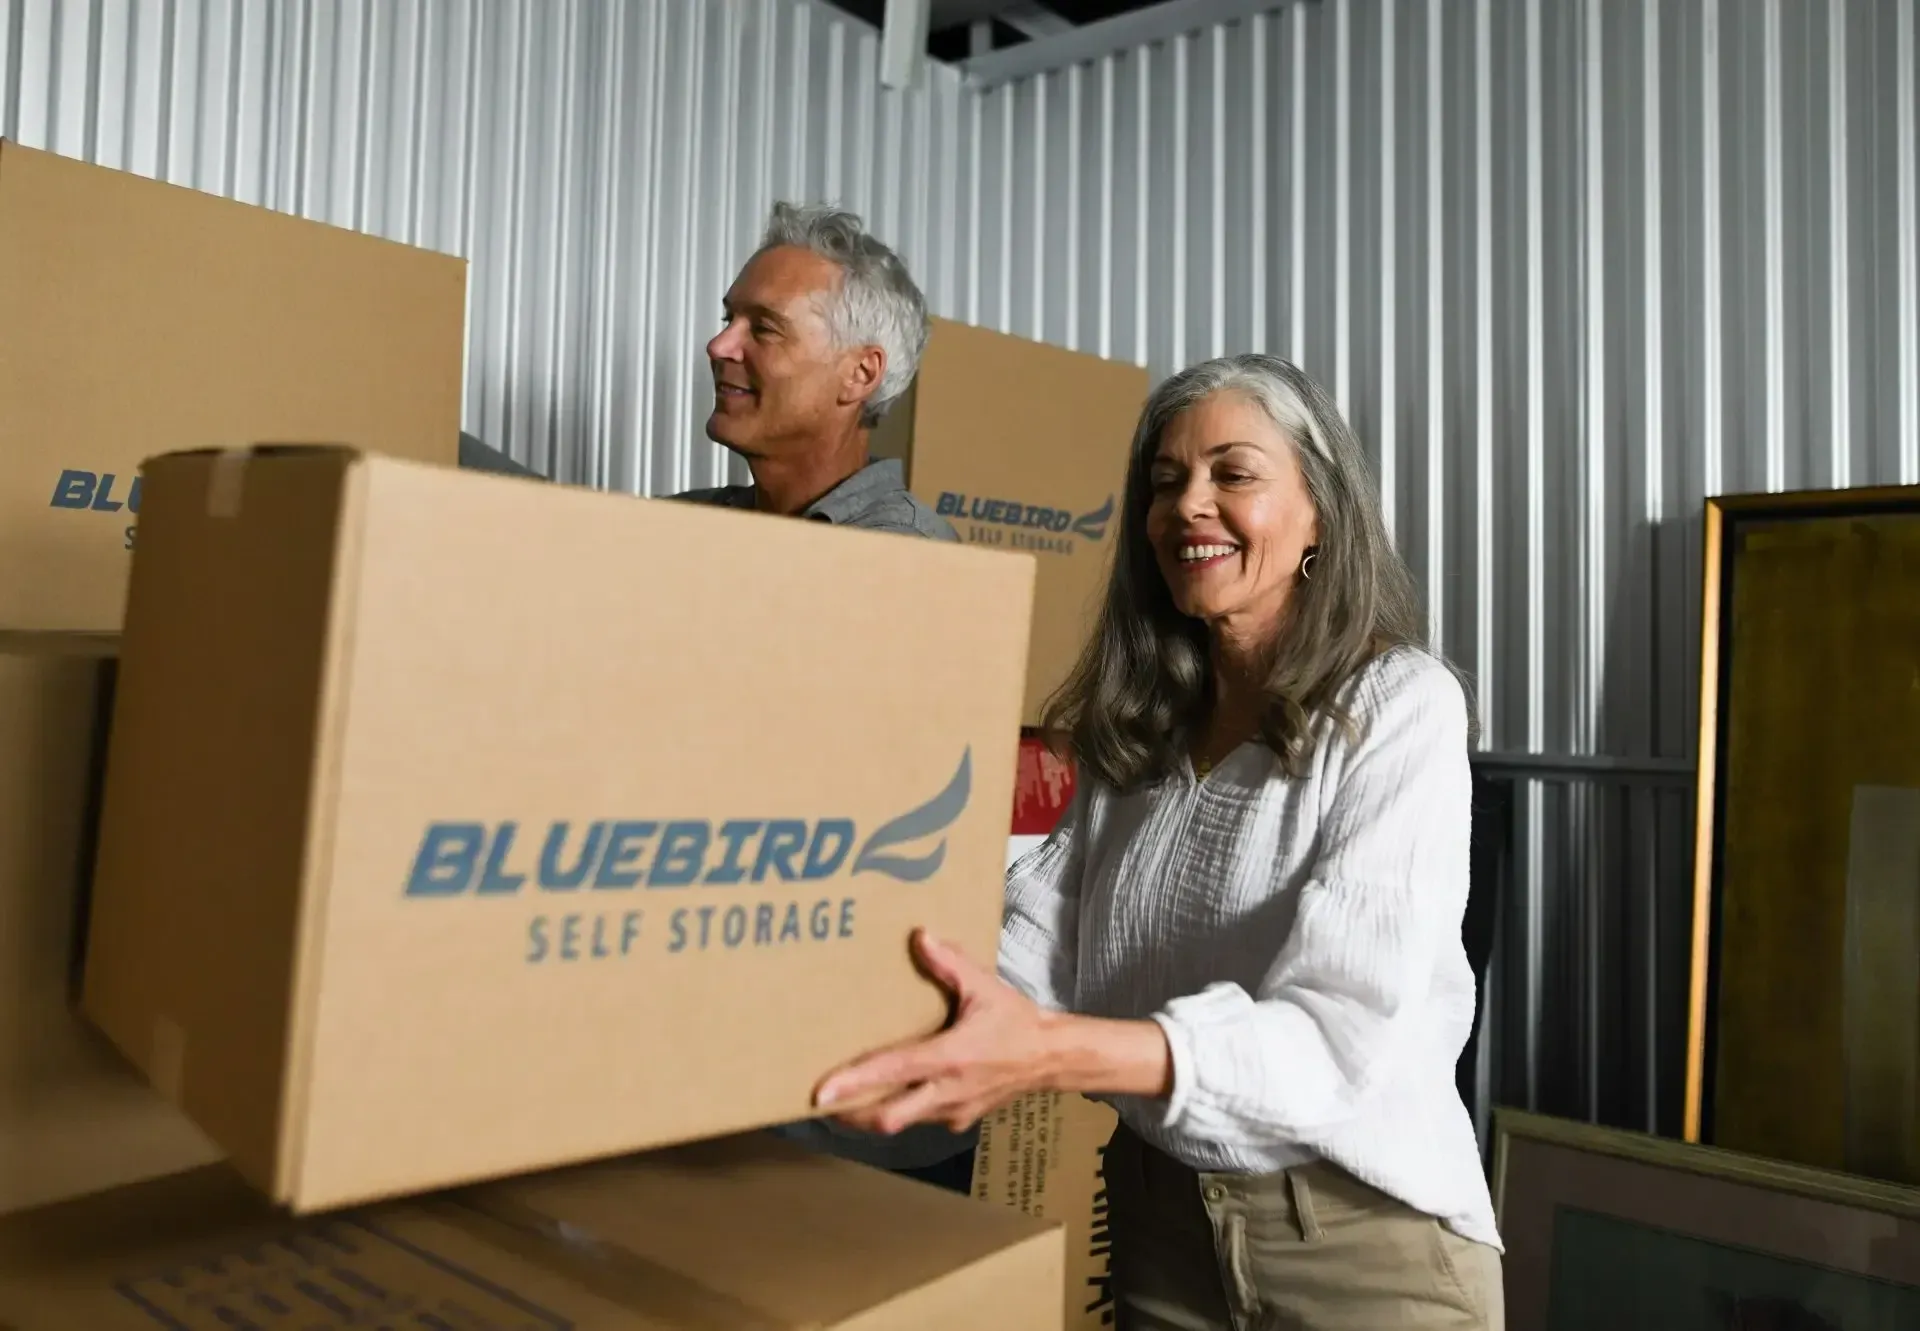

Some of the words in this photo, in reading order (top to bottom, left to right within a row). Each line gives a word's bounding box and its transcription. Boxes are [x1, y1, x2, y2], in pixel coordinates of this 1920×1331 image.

[936, 491, 1072, 533] BLUEBIRD
[404, 818, 857, 898] BLUEBIRD
[526, 909, 644, 964] SELF
[667, 898, 858, 954] STORAGE
